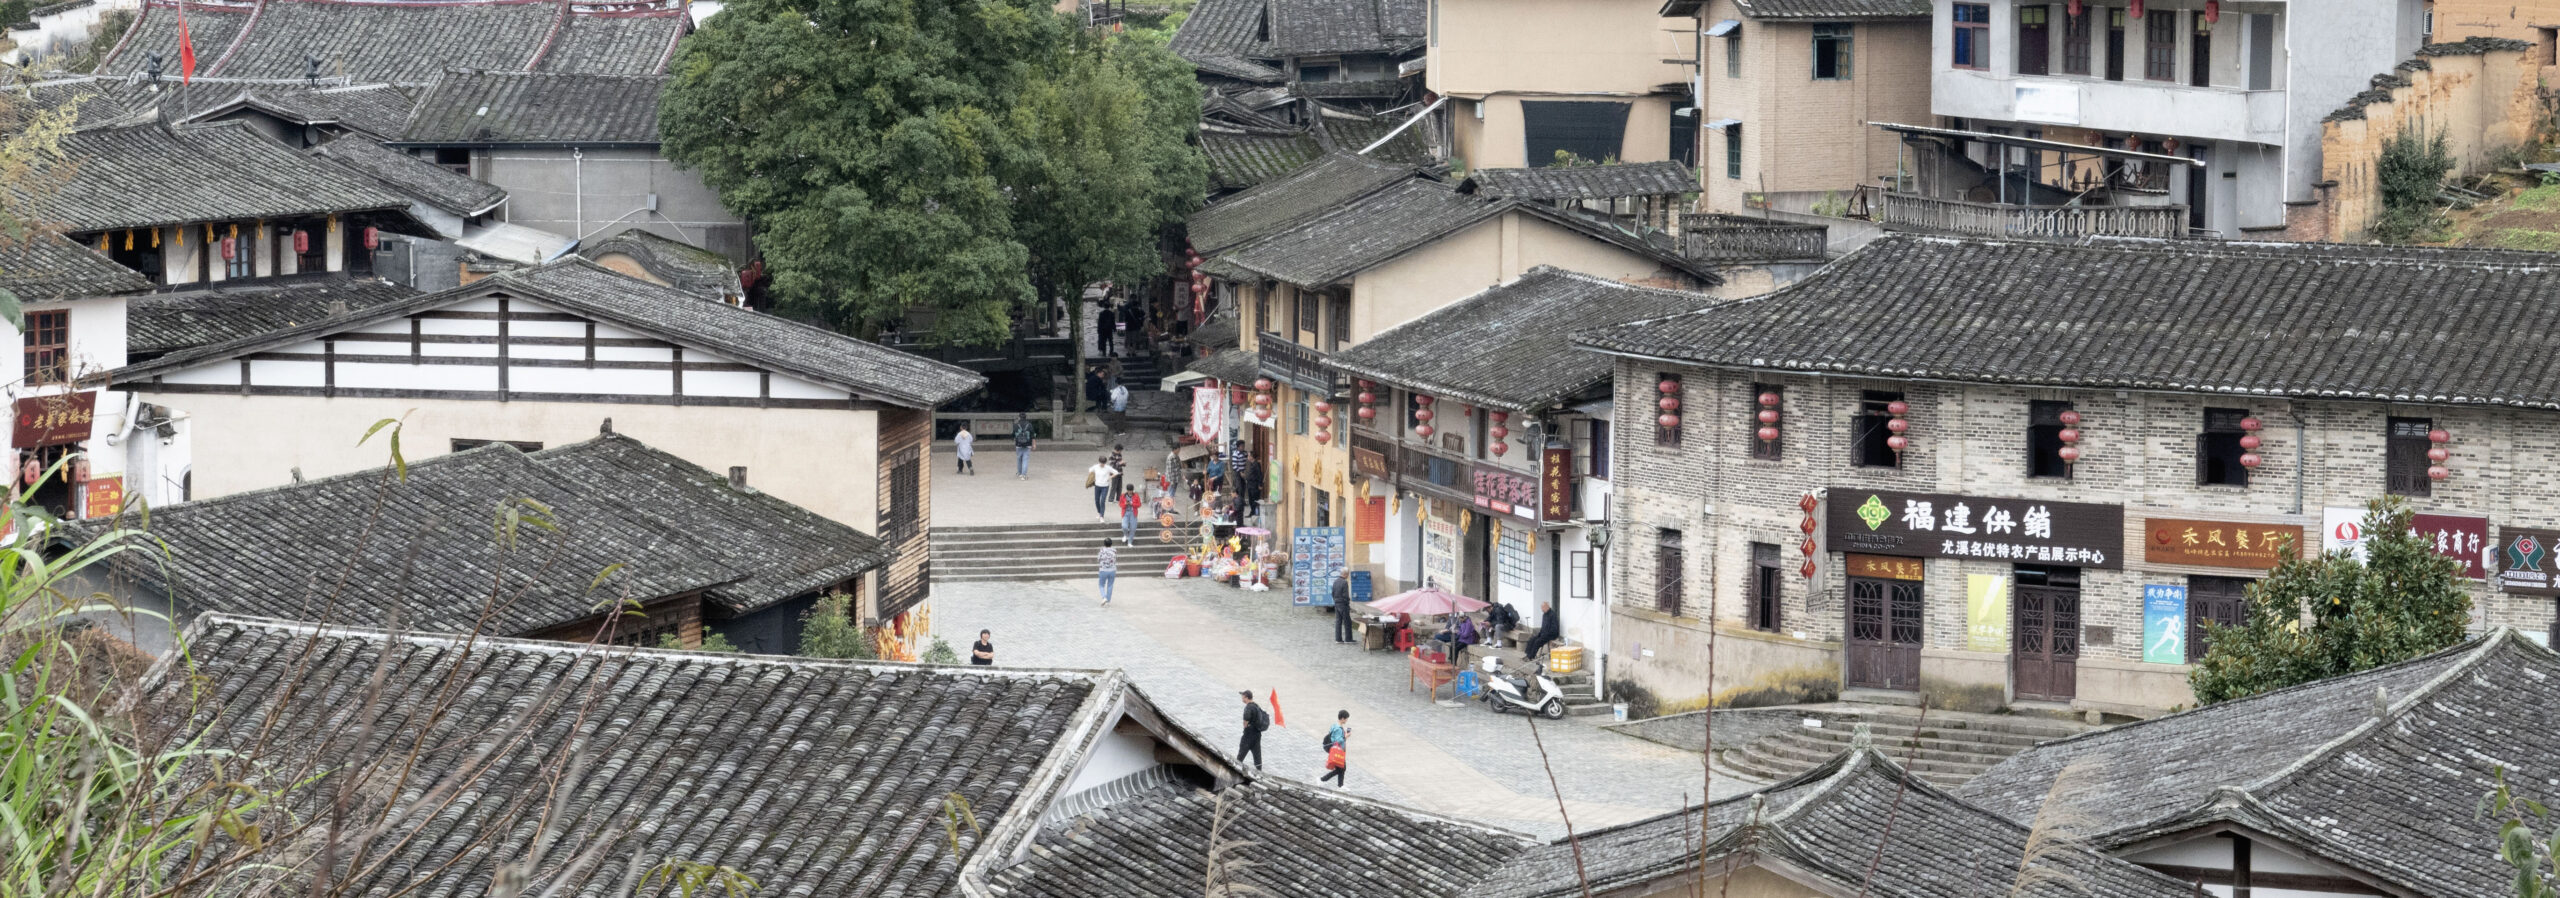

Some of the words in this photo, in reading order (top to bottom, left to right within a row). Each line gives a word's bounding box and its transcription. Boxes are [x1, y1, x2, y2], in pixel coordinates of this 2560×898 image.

[1550, 453, 1561, 516] 桂花香客栈
[1901, 499, 2052, 539] 福建供銷
[1941, 540, 2105, 564] 尤溪名优特农产品展示中心
[2182, 526, 2279, 552] 禾风餐厅
[1866, 560, 1920, 576] 禾风餐厅
